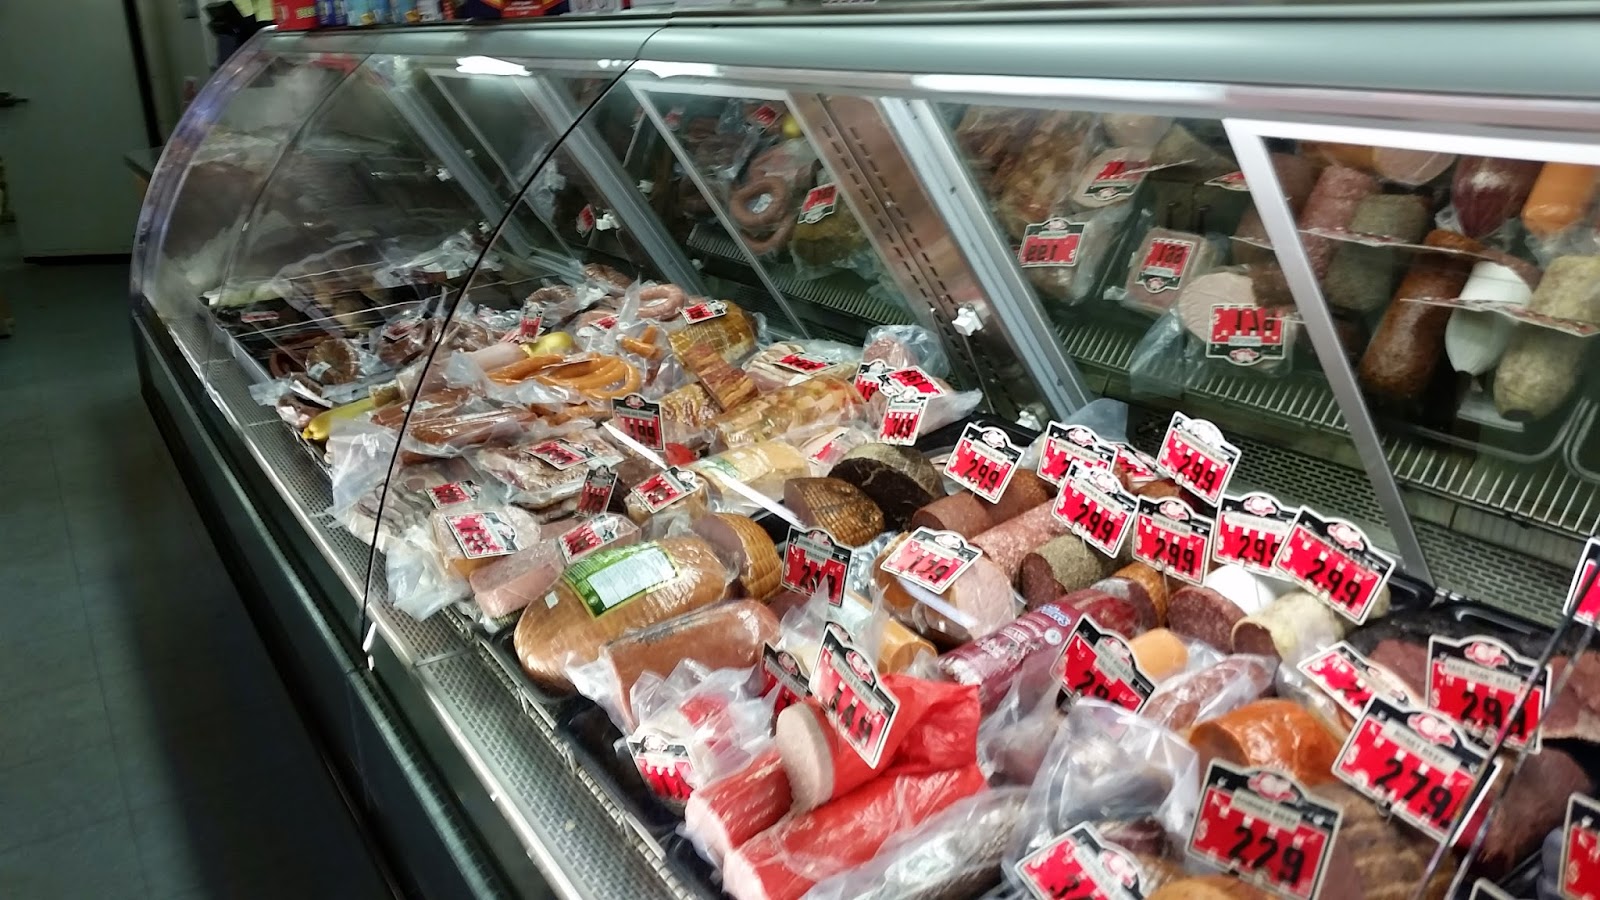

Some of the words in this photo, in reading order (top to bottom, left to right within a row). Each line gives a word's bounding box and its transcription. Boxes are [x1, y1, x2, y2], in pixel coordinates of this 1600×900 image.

[963, 456, 1000, 493] 299
[1177, 455, 1217, 492] 299
[1075, 503, 1115, 544] 299
[1153, 538, 1194, 575] 299
[1305, 559, 1362, 606] 299
[1375, 759, 1453, 821] 279
[1228, 826, 1305, 886] 229
